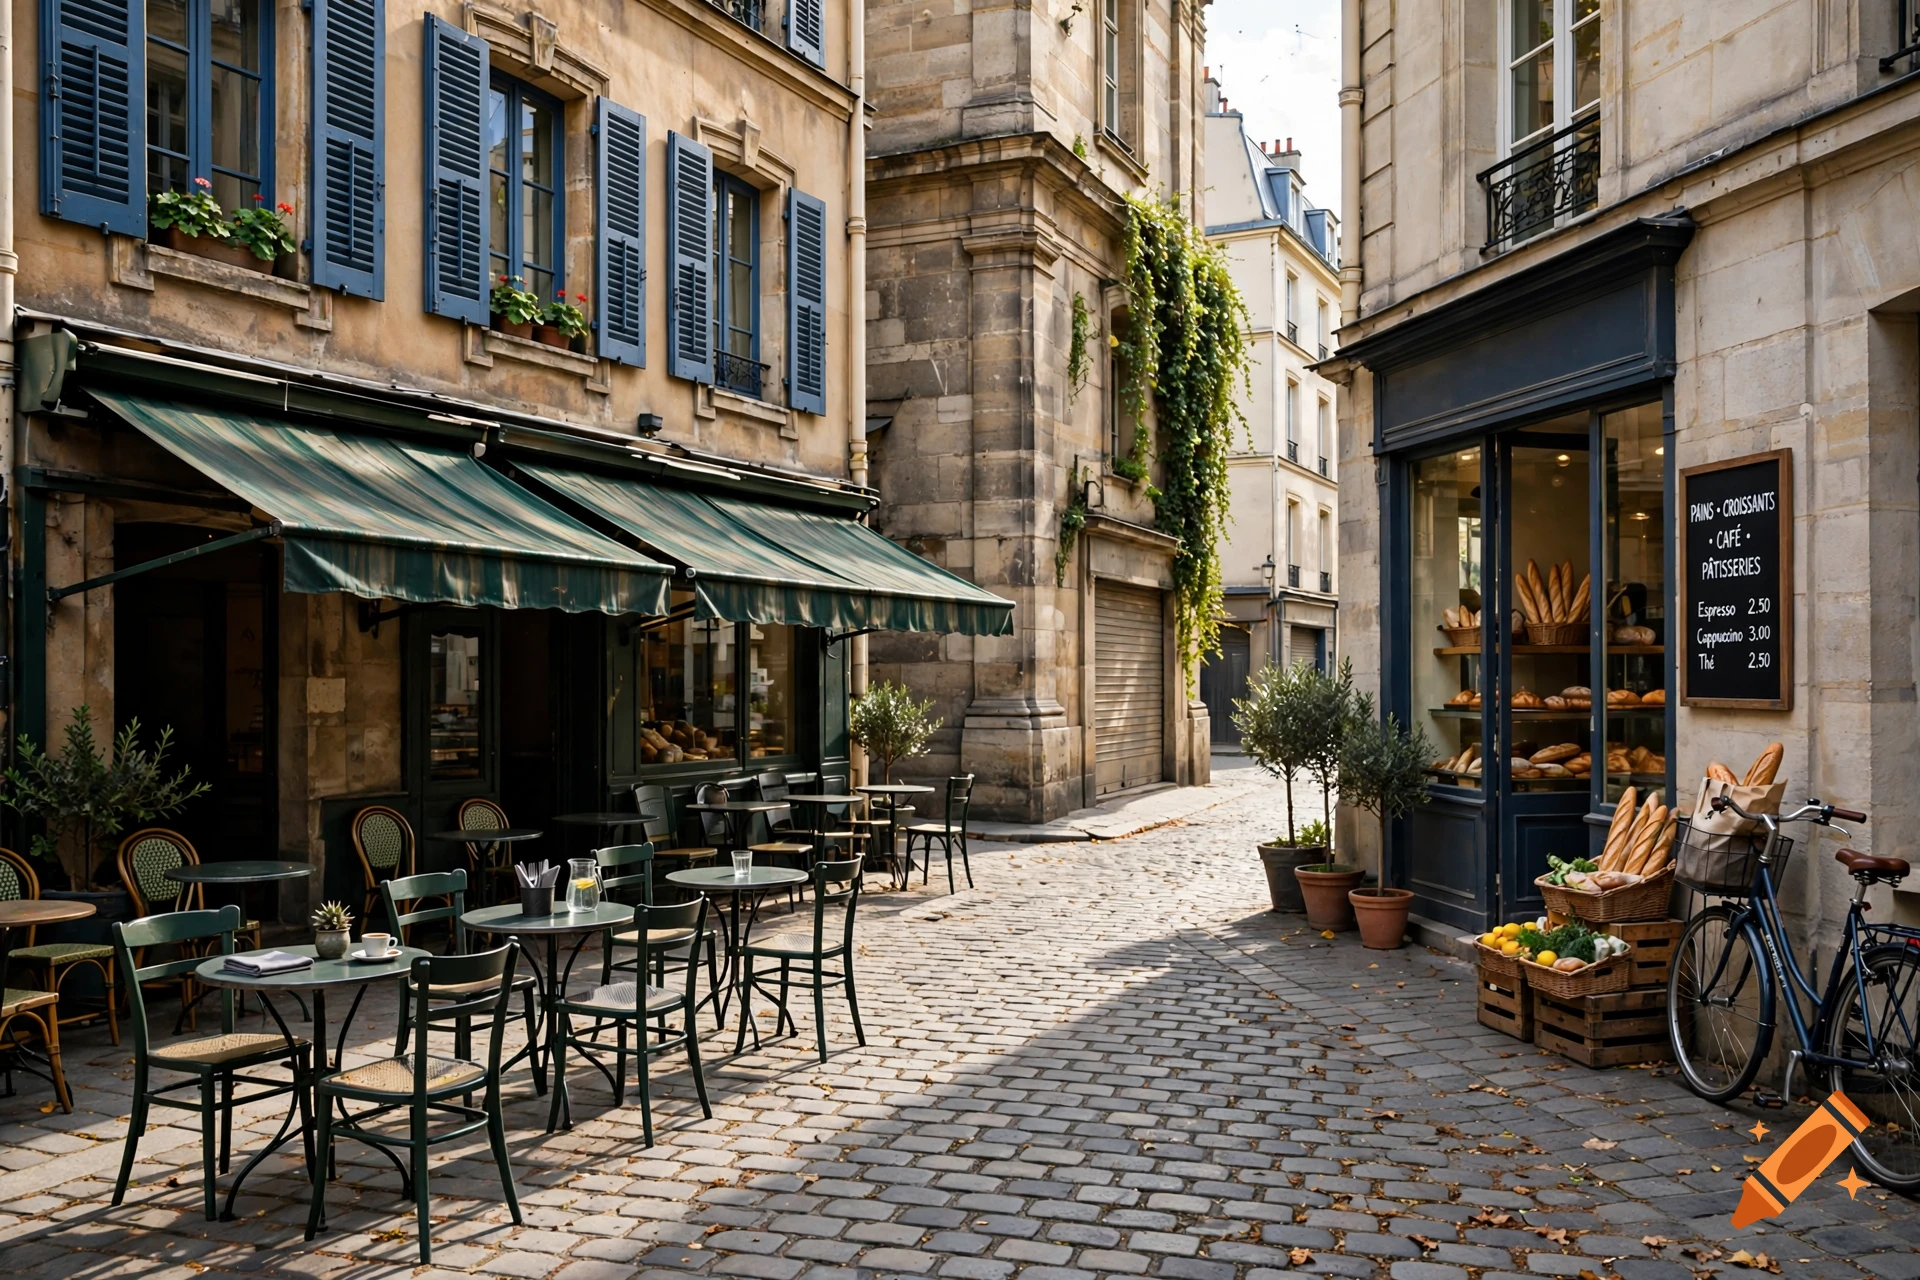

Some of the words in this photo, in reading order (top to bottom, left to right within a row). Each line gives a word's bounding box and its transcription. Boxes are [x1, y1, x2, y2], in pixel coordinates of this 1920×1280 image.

[1690, 501, 1714, 523] PAINS
[1722, 491, 1775, 518] CROISSANTS
[1716, 523, 1741, 549] CAFÉ
[1702, 556, 1761, 580] PÂTISSERIES
[1698, 601, 1736, 622] Espresso
[1747, 598, 1771, 615] 2.50
[1696, 627, 1744, 649] Cappuccino
[1748, 625, 1771, 642] 3.00
[1698, 653, 1715, 670] Thé
[1747, 652, 1771, 669] 2.50
